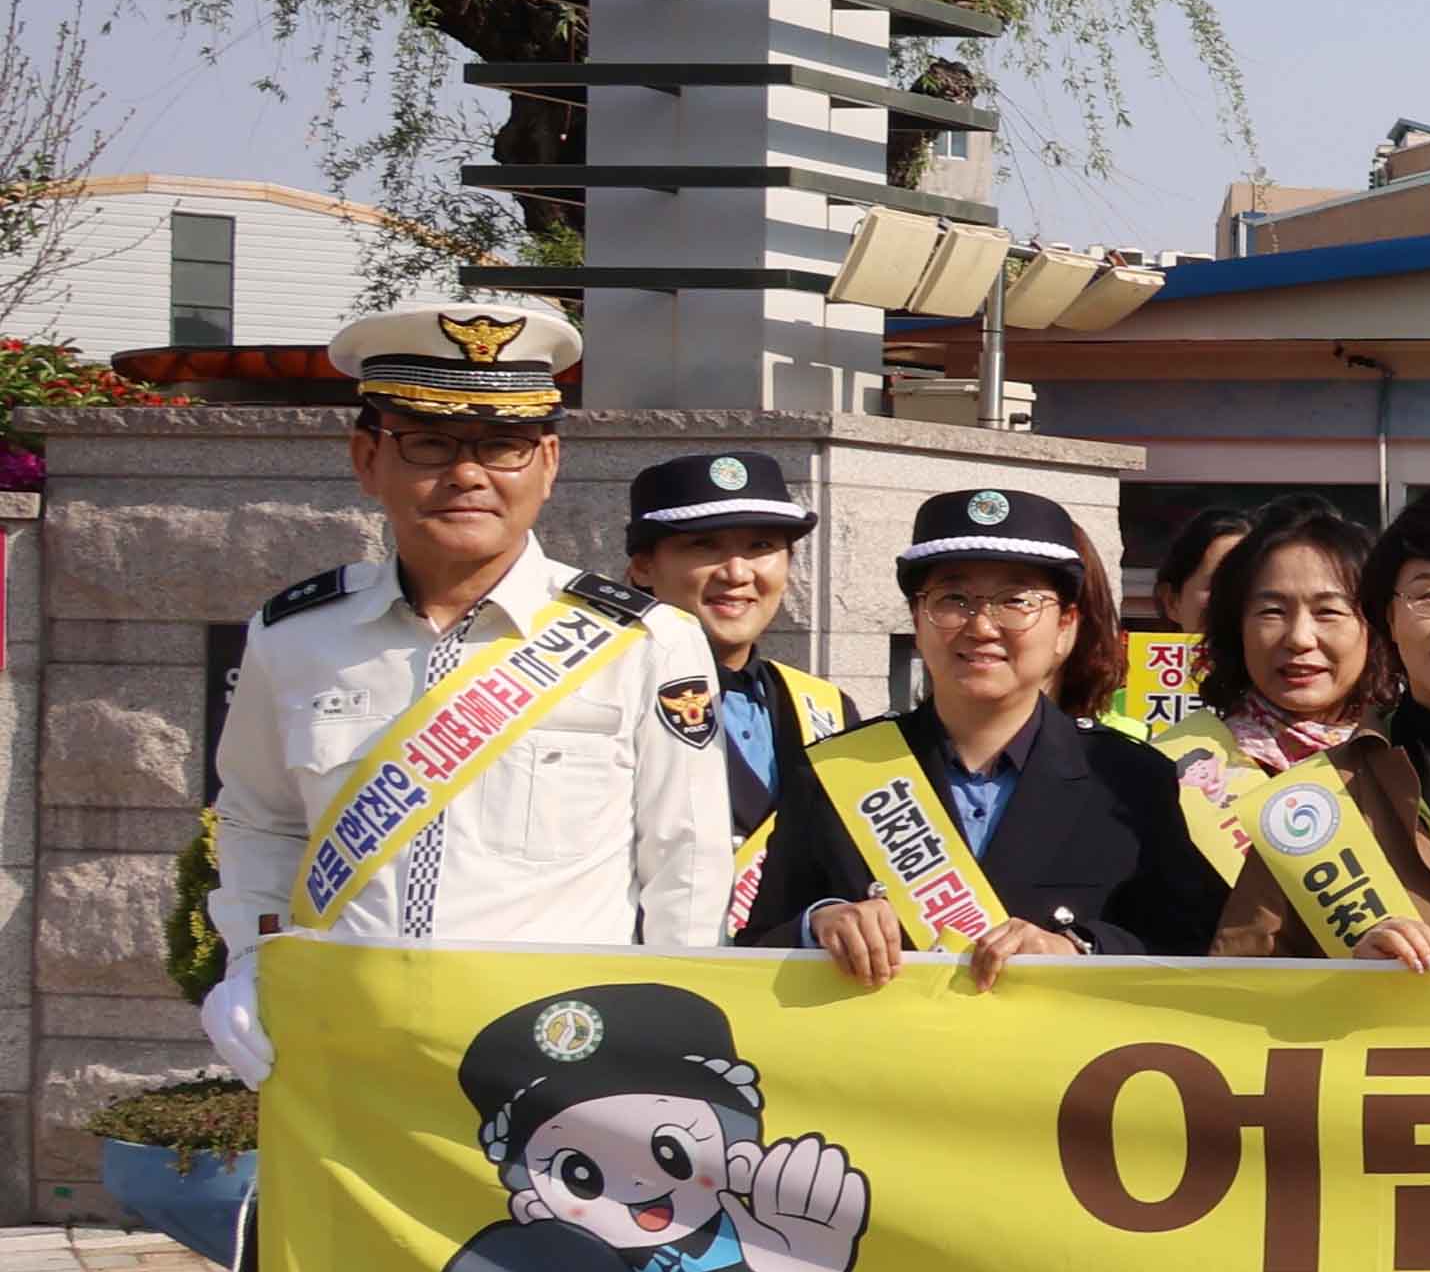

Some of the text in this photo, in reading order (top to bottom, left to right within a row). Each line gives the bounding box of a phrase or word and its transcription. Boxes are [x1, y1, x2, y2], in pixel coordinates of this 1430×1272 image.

[510, 600, 630, 687] 지킨
[404, 669, 535, 782] 교통법규
[337, 762, 427, 860] 안전한
[861, 779, 948, 882] 안전한
